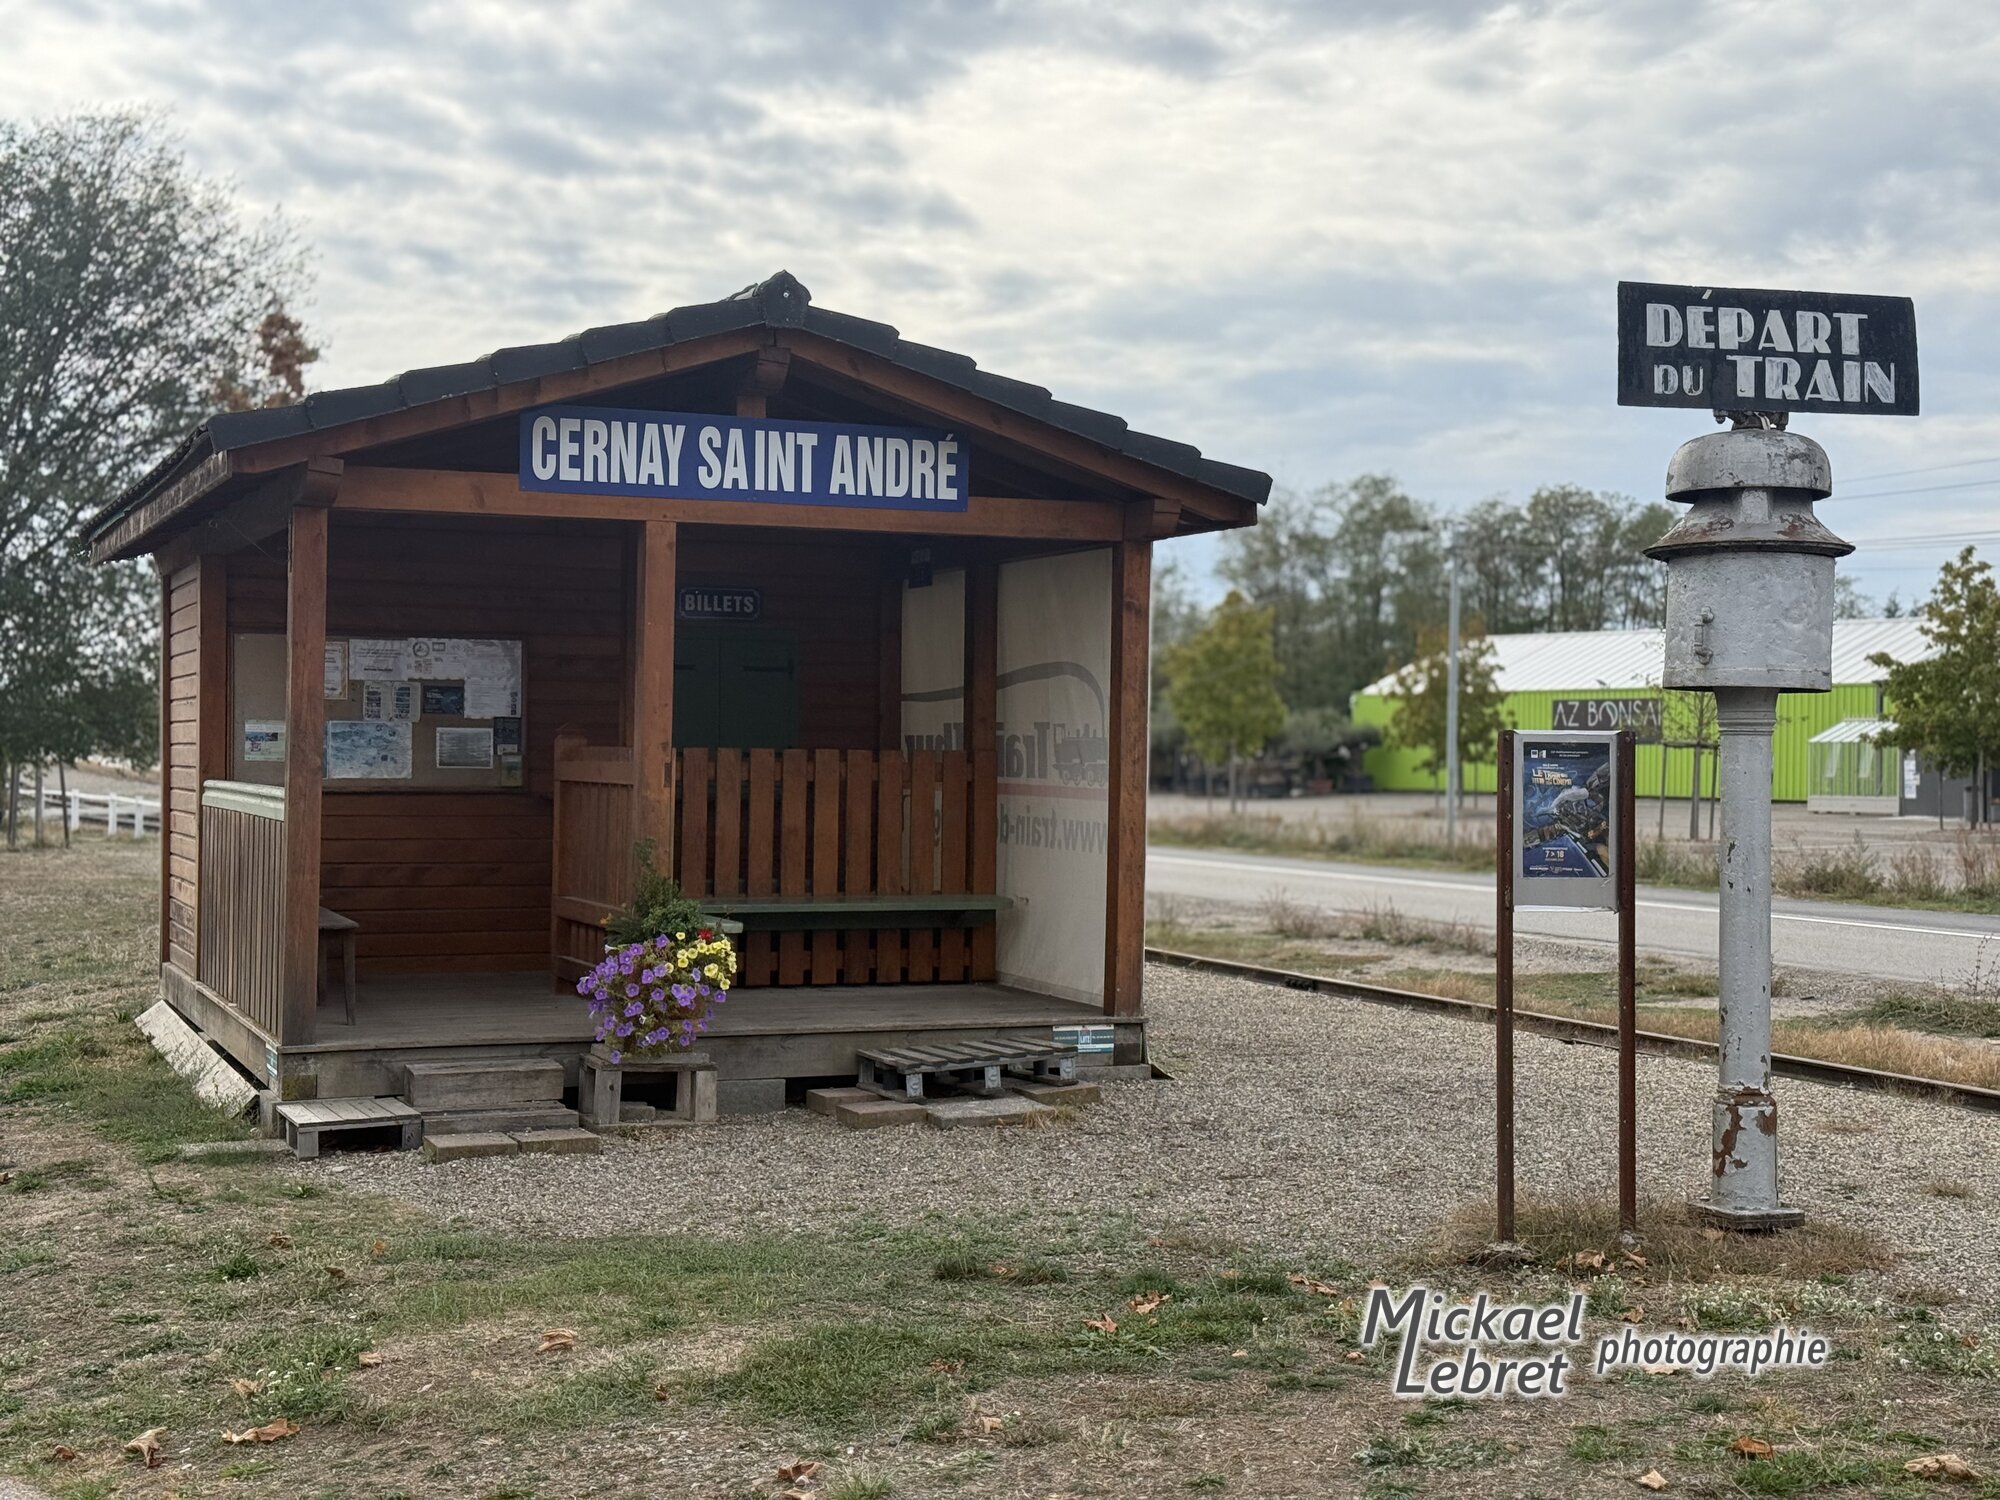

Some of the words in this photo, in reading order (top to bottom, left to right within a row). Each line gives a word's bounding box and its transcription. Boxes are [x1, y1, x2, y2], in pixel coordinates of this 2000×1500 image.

[1646, 289, 1868, 355] DÉPART
[1653, 364, 1704, 395] DU
[1726, 354, 1896, 404] TRAIN
[531, 415, 686, 487] CERNAY
[698, 425, 818, 494] SAINT
[829, 433, 959, 501] ANDRÉ
[685, 593, 754, 613] BILLETS
[1554, 701, 1580, 727] AZ
[1587, 700, 1661, 728] BONSAI
